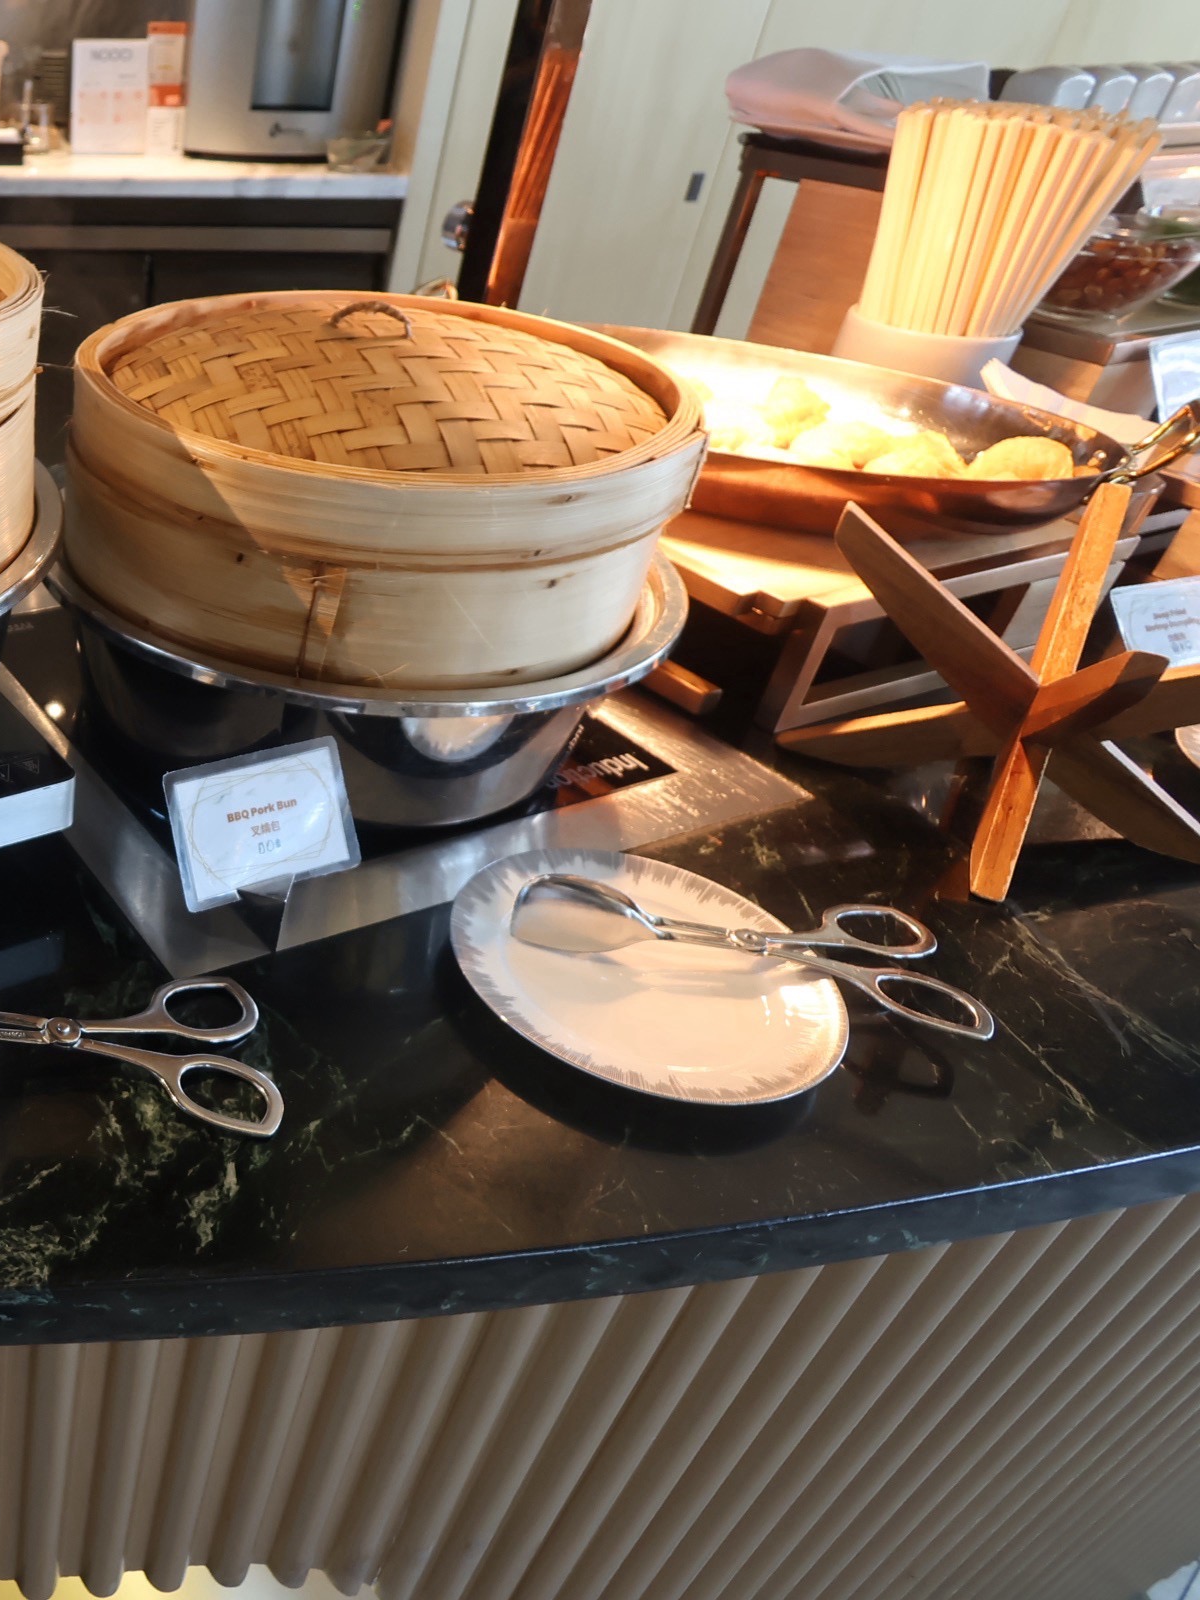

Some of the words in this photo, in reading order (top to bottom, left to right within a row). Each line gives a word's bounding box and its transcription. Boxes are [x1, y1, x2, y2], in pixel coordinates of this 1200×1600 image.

[227, 808, 250, 823] BBQ
[251, 803, 275, 817] Pork
[277, 798, 297, 811] Bun
